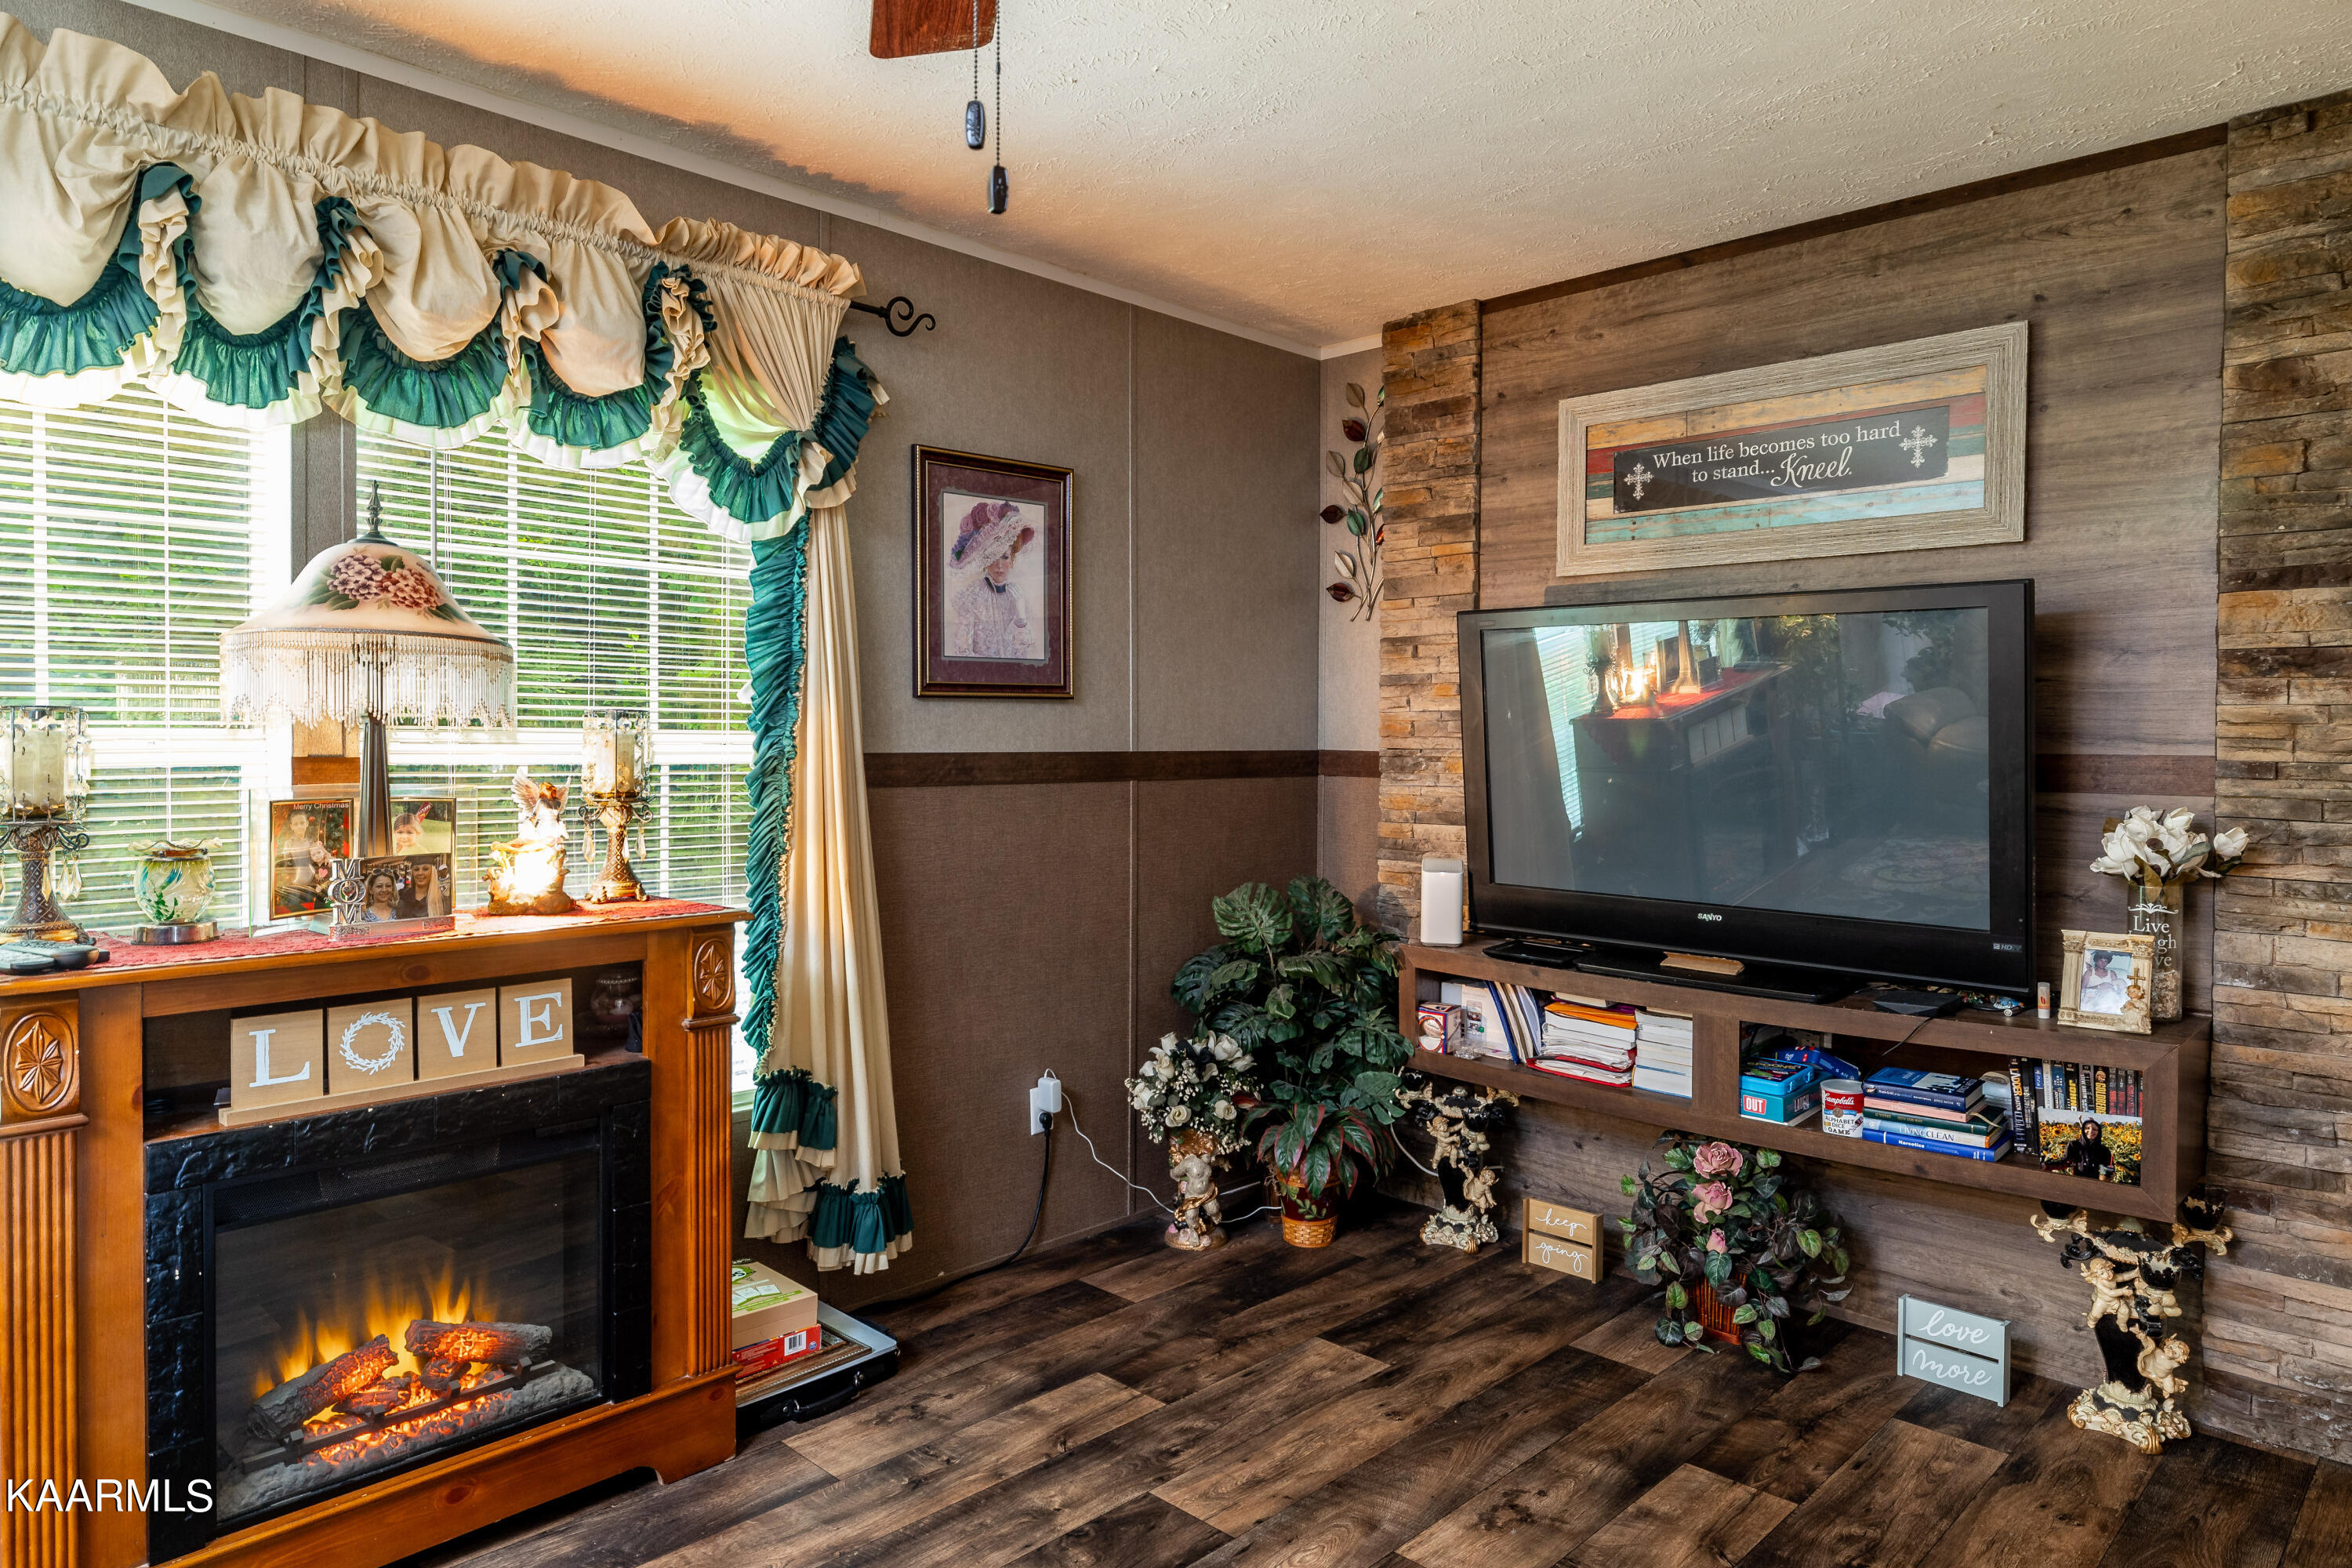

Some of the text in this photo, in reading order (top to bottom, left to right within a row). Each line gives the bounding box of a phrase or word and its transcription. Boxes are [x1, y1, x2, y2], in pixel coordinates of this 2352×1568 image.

[1653, 419, 1902, 470] When life becomes too hard
[1692, 445, 1853, 488] to stand... Kneel.
[293, 802, 312, 811] Merry
[1697, 913, 1722, 922] SANYO
[2132, 915, 2170, 933] Live
[2009, 1068, 2023, 1097] LADDER
[1745, 1097, 1764, 1113] OUT
[1825, 1116, 1855, 1124] ALPHABET
[1828, 1127, 1851, 1135] GAME
[1899, 1125, 1955, 1142] LIVING CLEAN
[1535, 1208, 1588, 1237] keep
[1535, 1242, 1589, 1273] going
[1918, 1309, 1991, 1344] love
[1912, 1348, 1992, 1385] more
